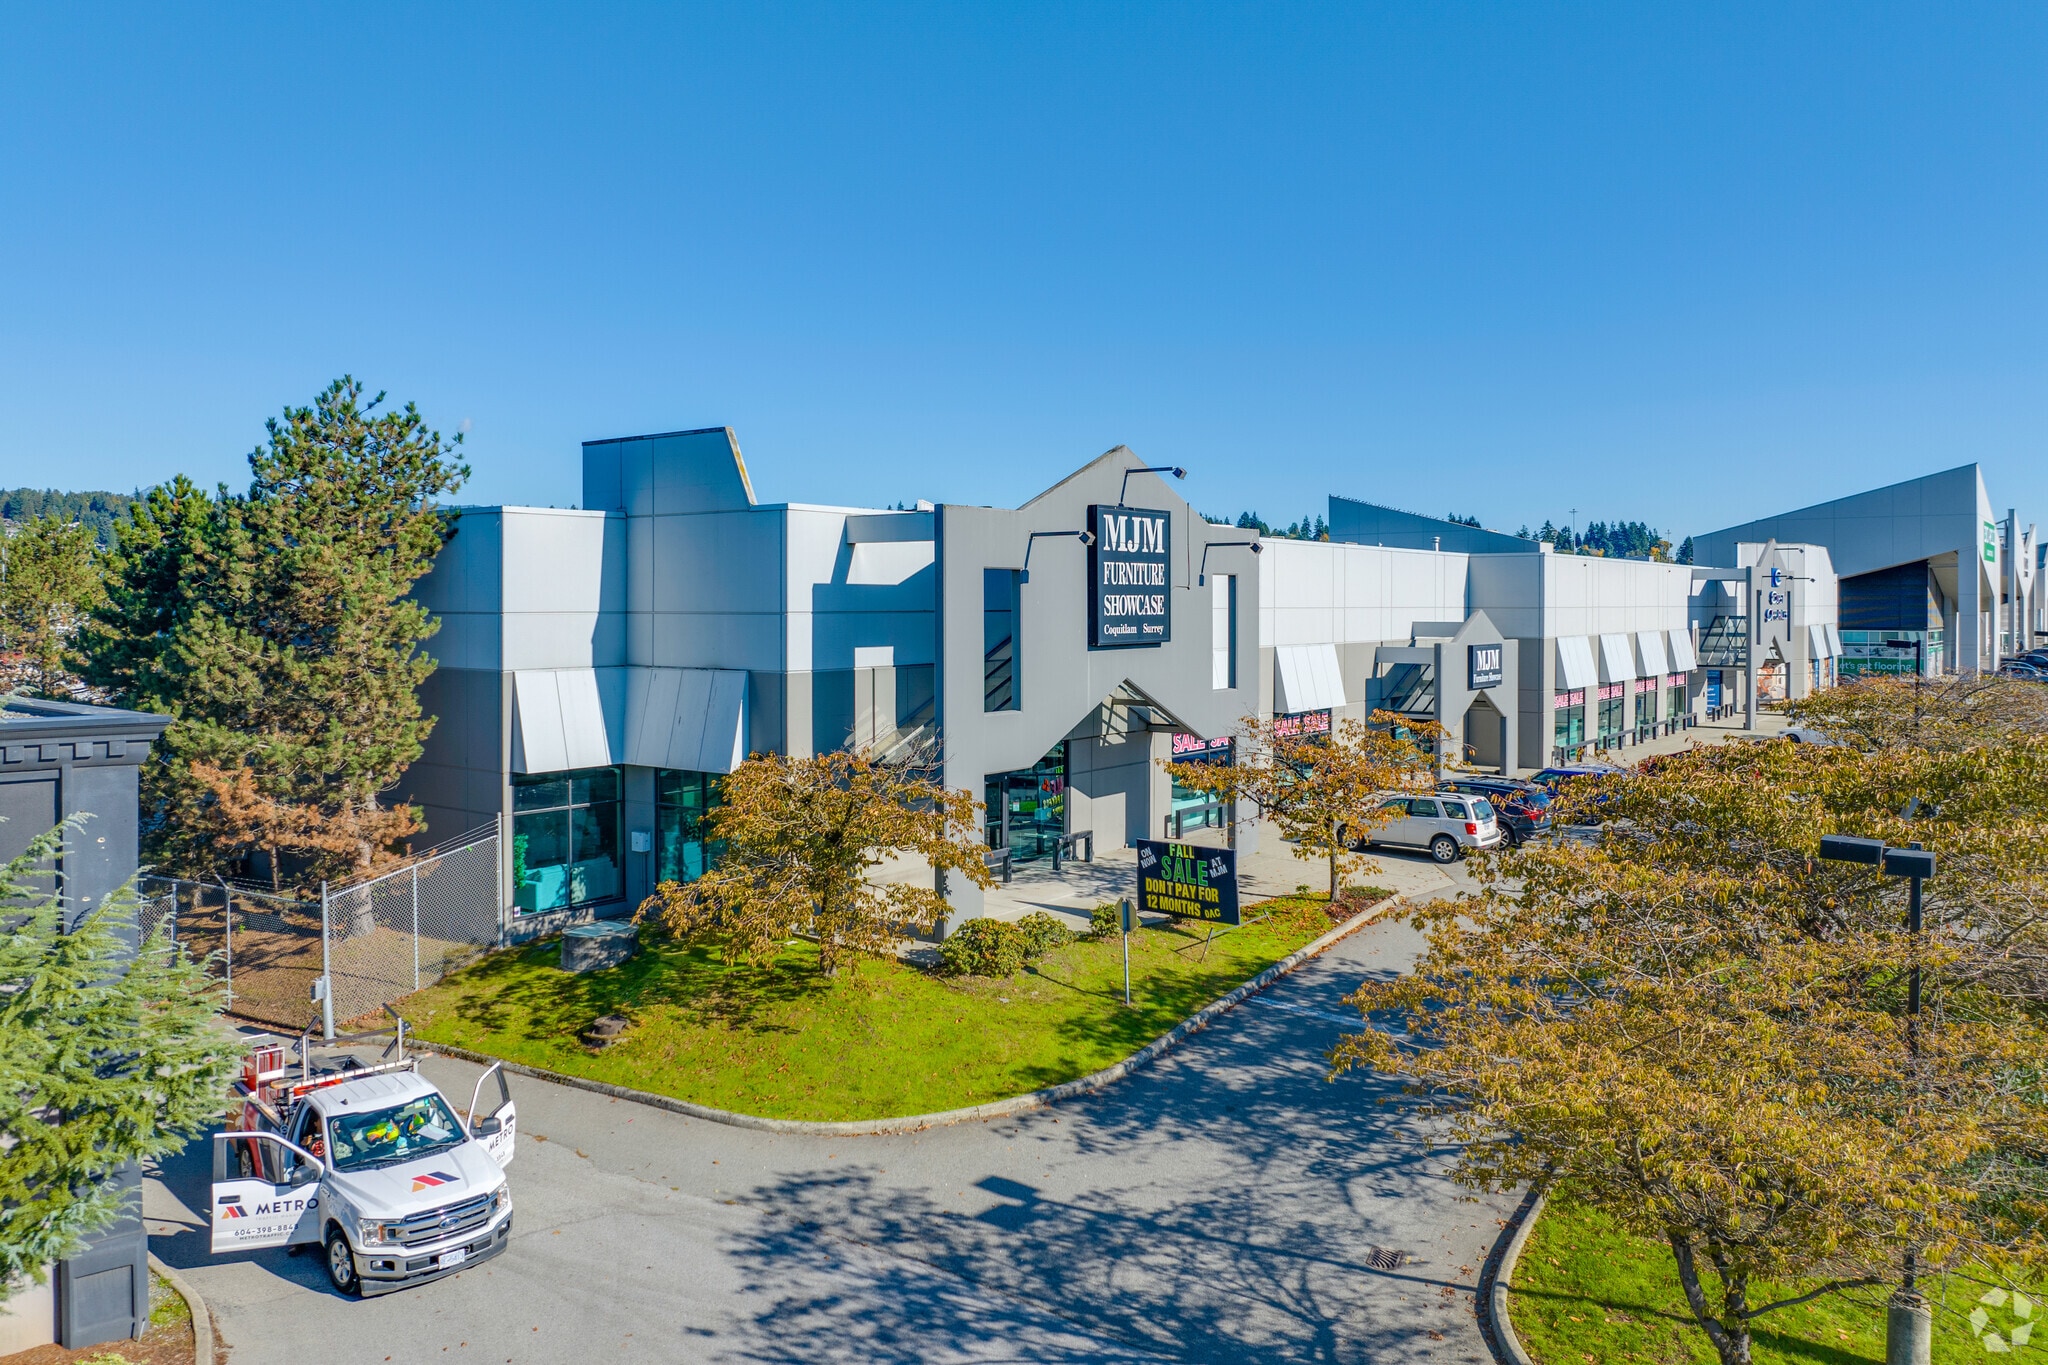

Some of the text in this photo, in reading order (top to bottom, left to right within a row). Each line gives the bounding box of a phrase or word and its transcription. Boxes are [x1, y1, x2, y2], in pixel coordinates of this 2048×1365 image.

[1103, 514, 1165, 554] MJM
[1103, 561, 1165, 586] FURNITURE
[1103, 594, 1165, 616] SHOWCASE
[1104, 623, 1164, 637] Coquitlam Surrey
[1476, 649, 1500, 671] MJM
[1857, 663, 1872, 673] get
[1274, 712, 1329, 737] SALE SALE
[1173, 733, 1205, 753] SALE
[1140, 847, 1152, 857] ON
[1169, 843, 1195, 859] FALL
[1140, 855, 1157, 869] NOW
[1161, 855, 1208, 886] SALE
[1209, 864, 1228, 878] MJM
[1211, 856, 1222, 868] AT
[1175, 882, 1196, 899] PAY
[1198, 886, 1219, 903] FOR
[1146, 894, 1158, 909] 12
[1159, 895, 1201, 917] MONTHS
[255, 1198, 319, 1215] METRO
